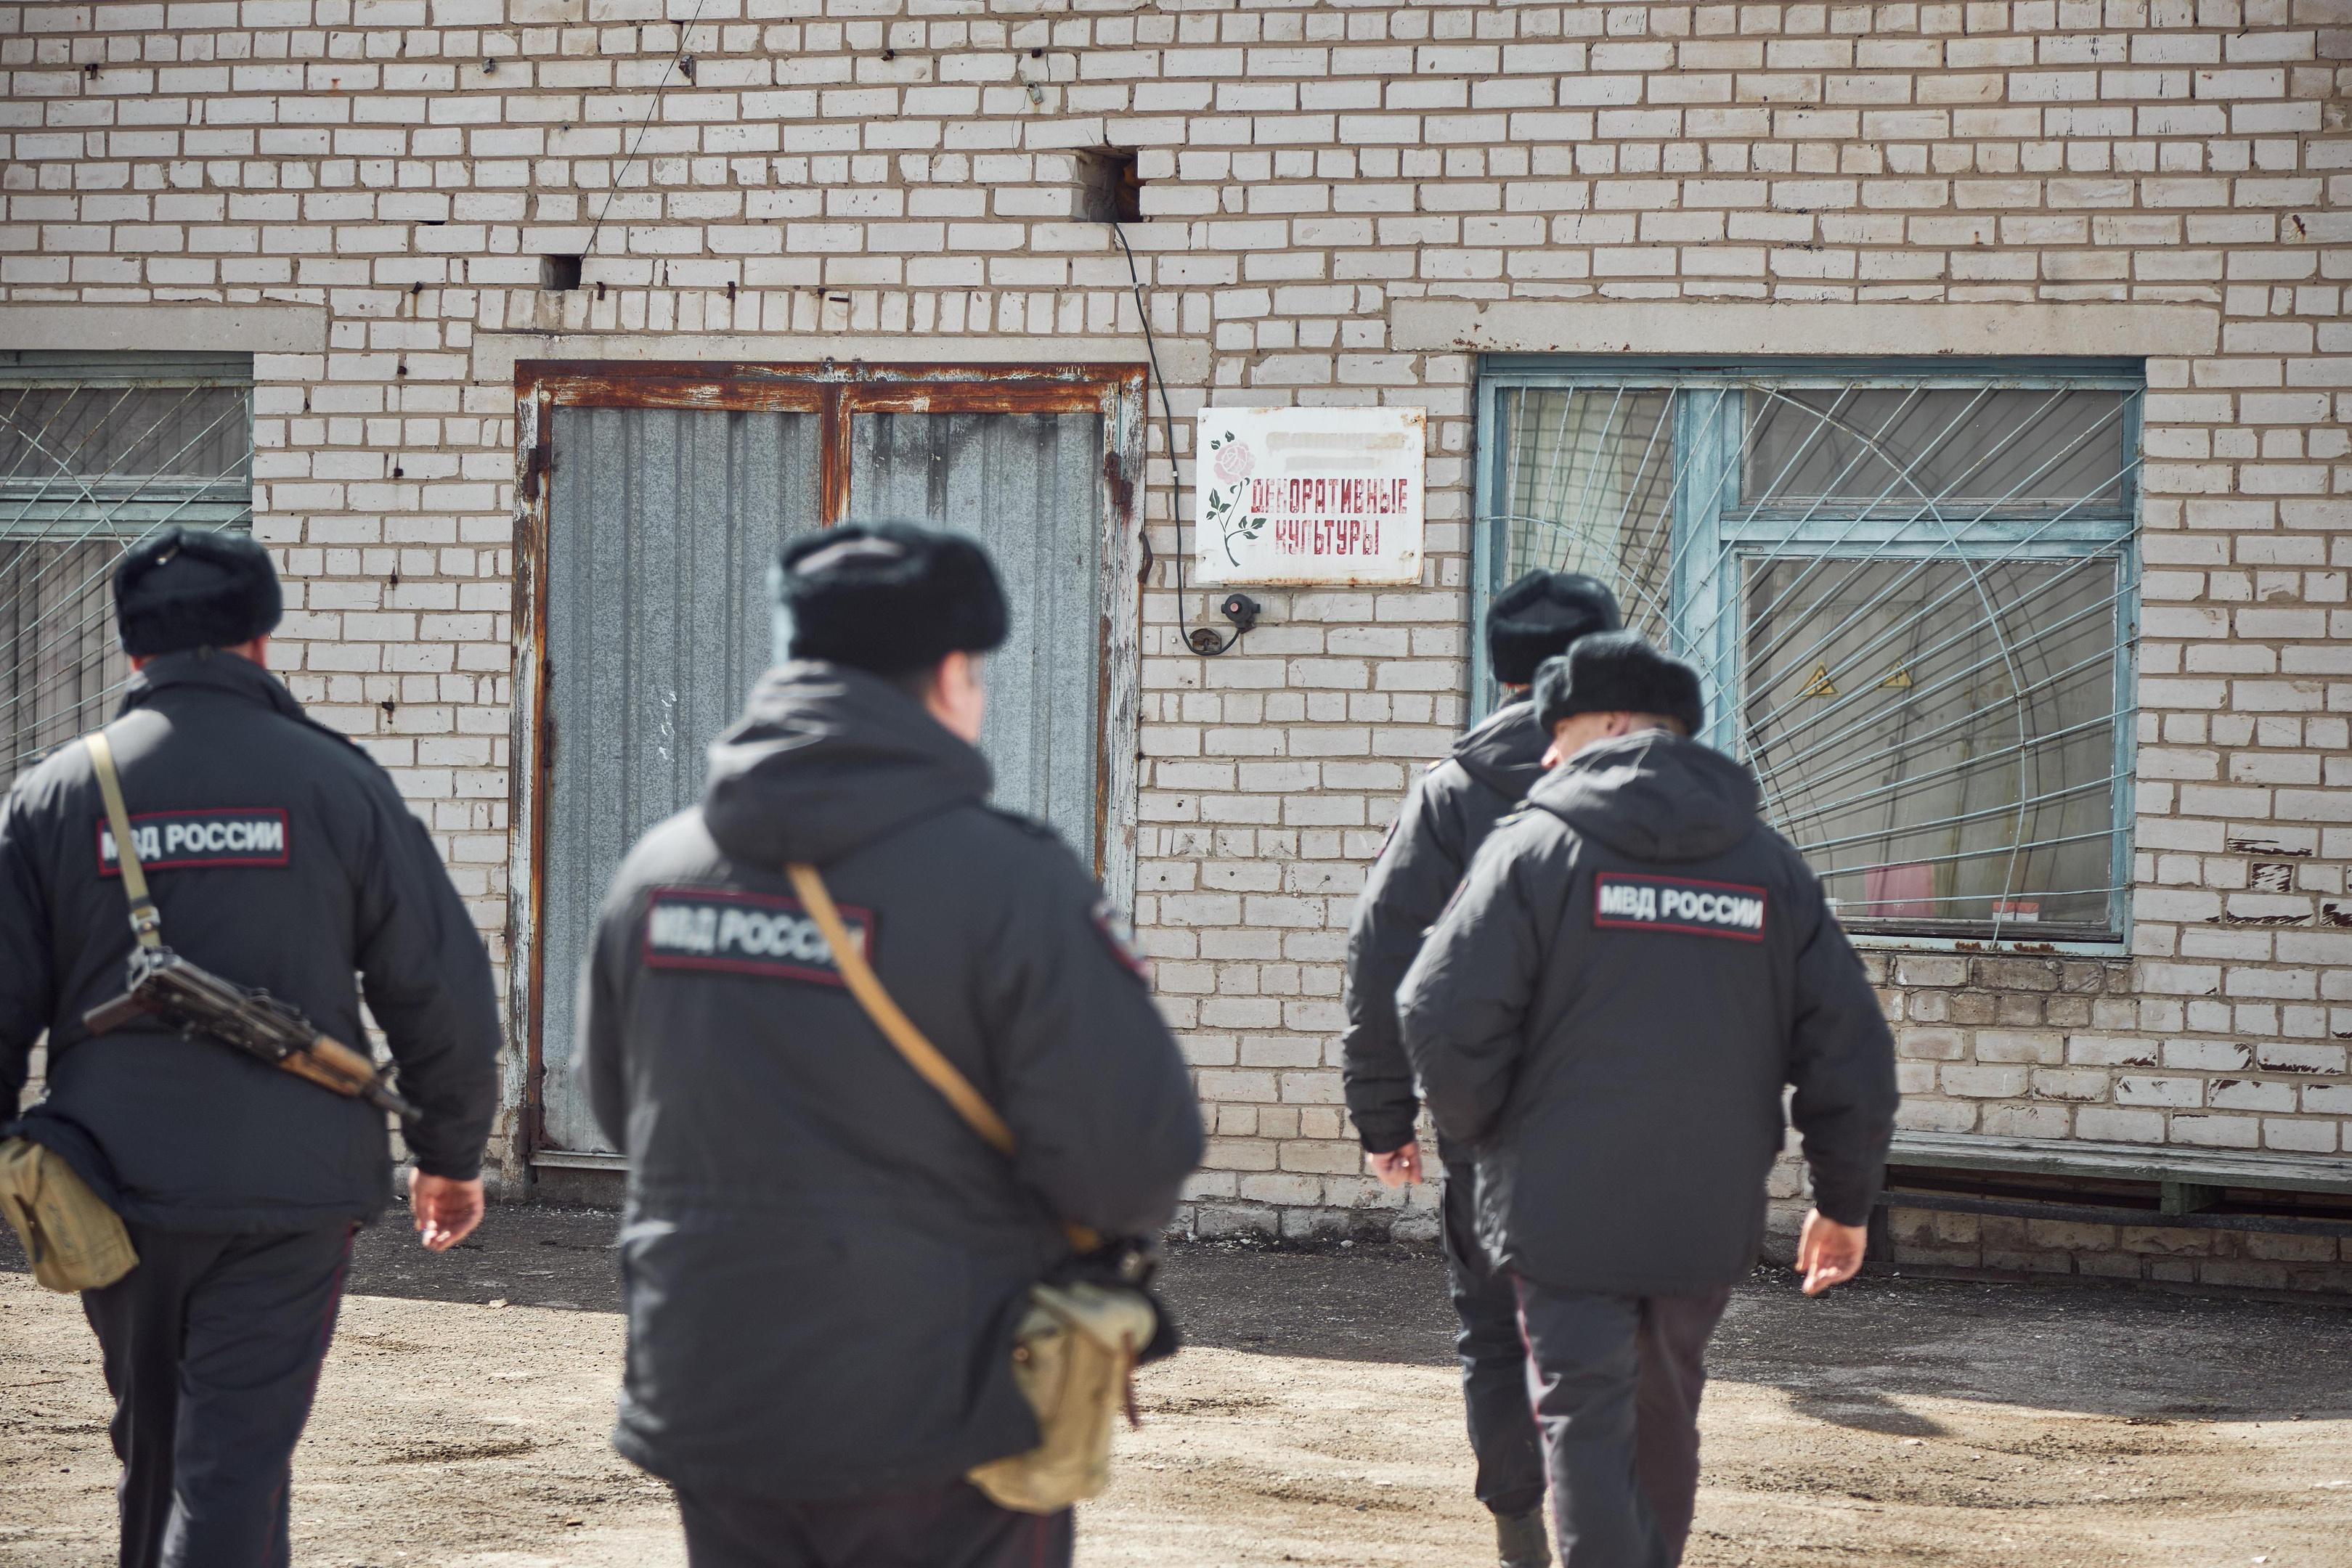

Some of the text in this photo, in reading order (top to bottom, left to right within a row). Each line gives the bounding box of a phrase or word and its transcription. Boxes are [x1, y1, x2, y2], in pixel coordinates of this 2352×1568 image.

[1275, 519, 1380, 555] КУЛЬТУРЫ
[166, 821, 284, 853] РОССИИ
[1600, 885, 1764, 929] МВД РОССИИ
